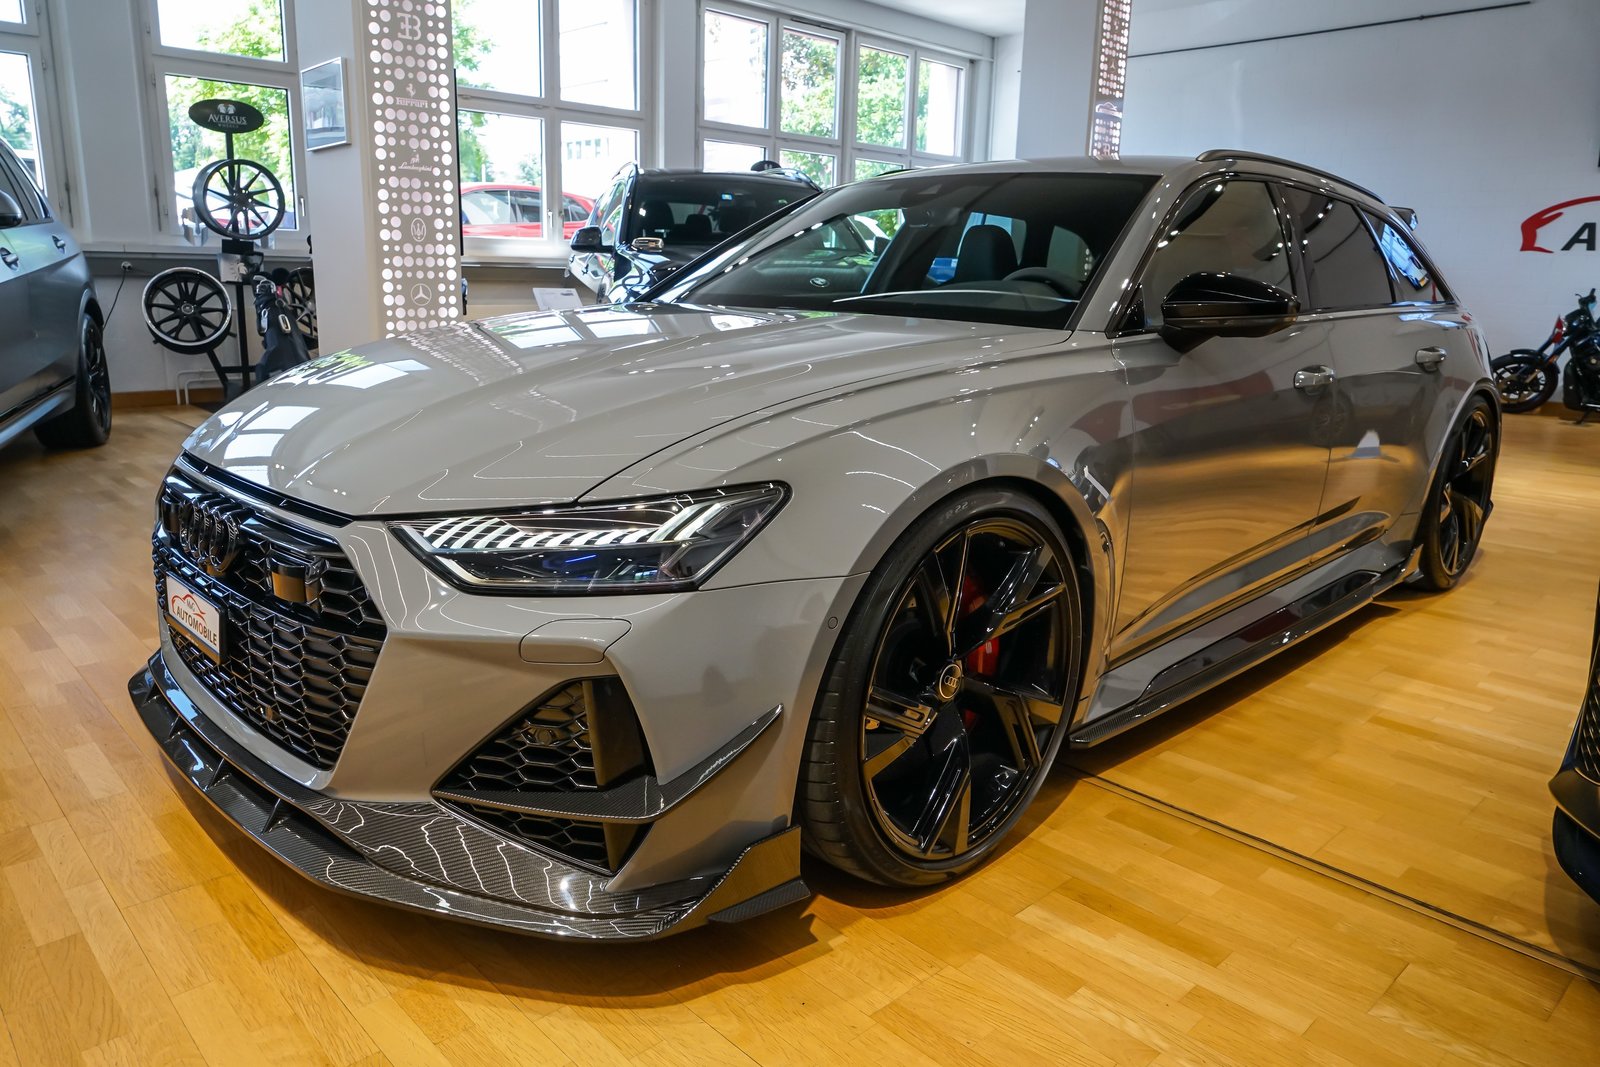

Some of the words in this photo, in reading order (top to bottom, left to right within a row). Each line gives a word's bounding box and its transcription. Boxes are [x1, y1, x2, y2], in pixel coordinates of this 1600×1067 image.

[396, 96, 428, 108] Ferrari
[207, 113, 248, 126] AVERSUS
[176, 605, 218, 646] AUTOMOBILE
